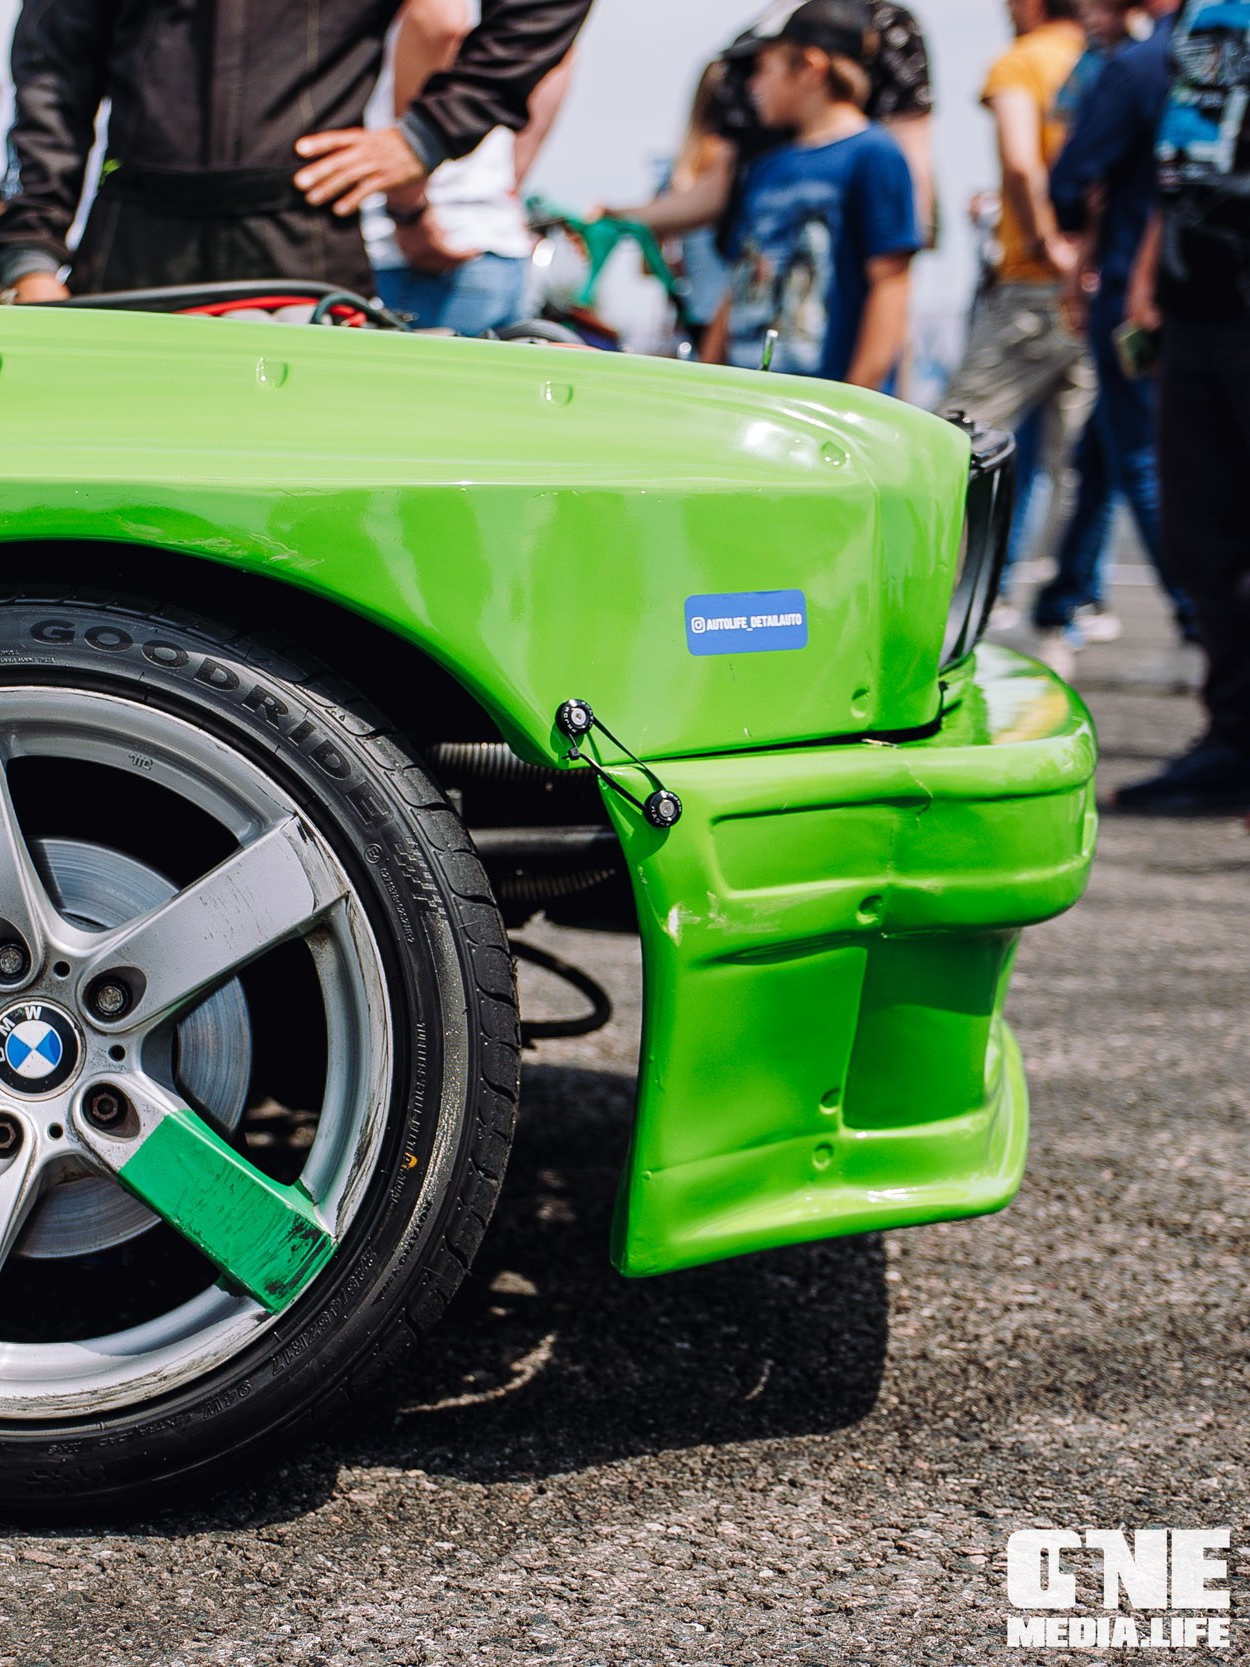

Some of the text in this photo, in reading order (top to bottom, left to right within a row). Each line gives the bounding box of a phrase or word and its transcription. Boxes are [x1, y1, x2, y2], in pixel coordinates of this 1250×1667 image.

[706, 612, 803, 632] AUTOLIFE_DETAILAUTO
[30, 618, 390, 827] GOODRIDE
[202, 1252, 379, 1419] 225/45ZR17 94W
